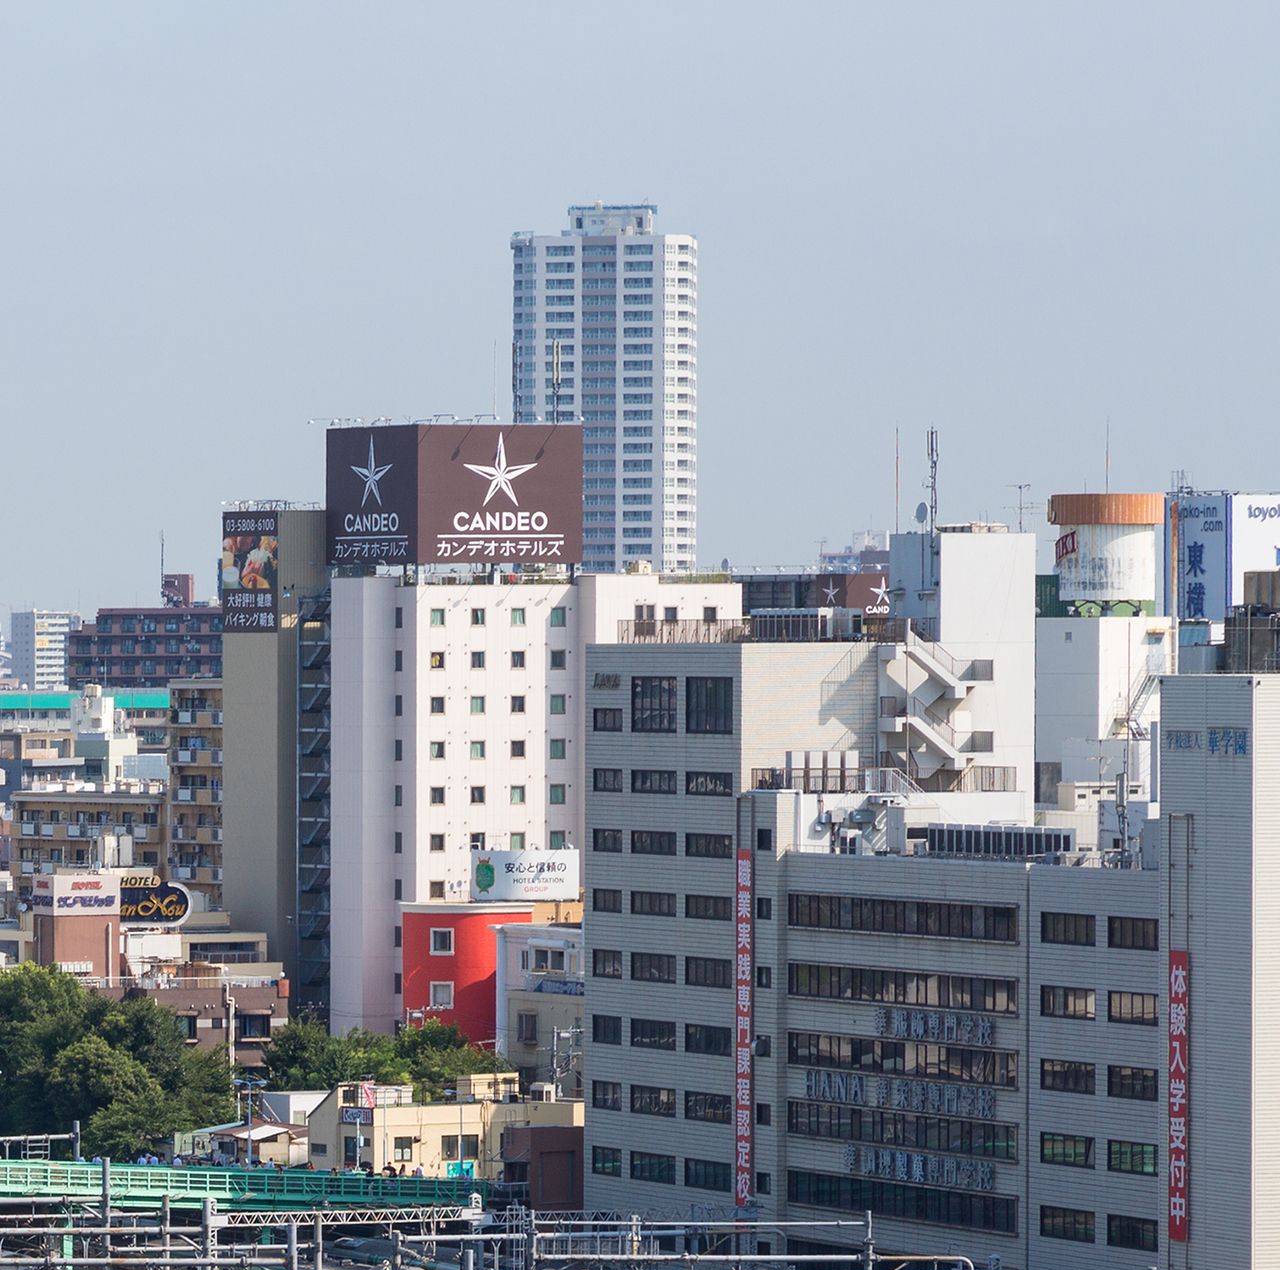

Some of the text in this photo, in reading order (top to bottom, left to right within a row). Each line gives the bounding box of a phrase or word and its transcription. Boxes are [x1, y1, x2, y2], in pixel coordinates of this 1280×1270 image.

[225, 518, 275, 532] 03-5808-6100
[344, 513, 400, 533] CANDEO
[453, 511, 549, 532] CANDEO
[1200, 518, 1223, 533] .com
[334, 540, 409, 558] カンデオホテルズ
[436, 539, 565, 557] カンデオホテルズ
[1206, 728, 1248, 755] 華学園
[504, 862, 567, 874] 安心と信頼の
[120, 876, 158, 887] HOTEL
[1169, 964, 1187, 1226] 体験入学受付中
